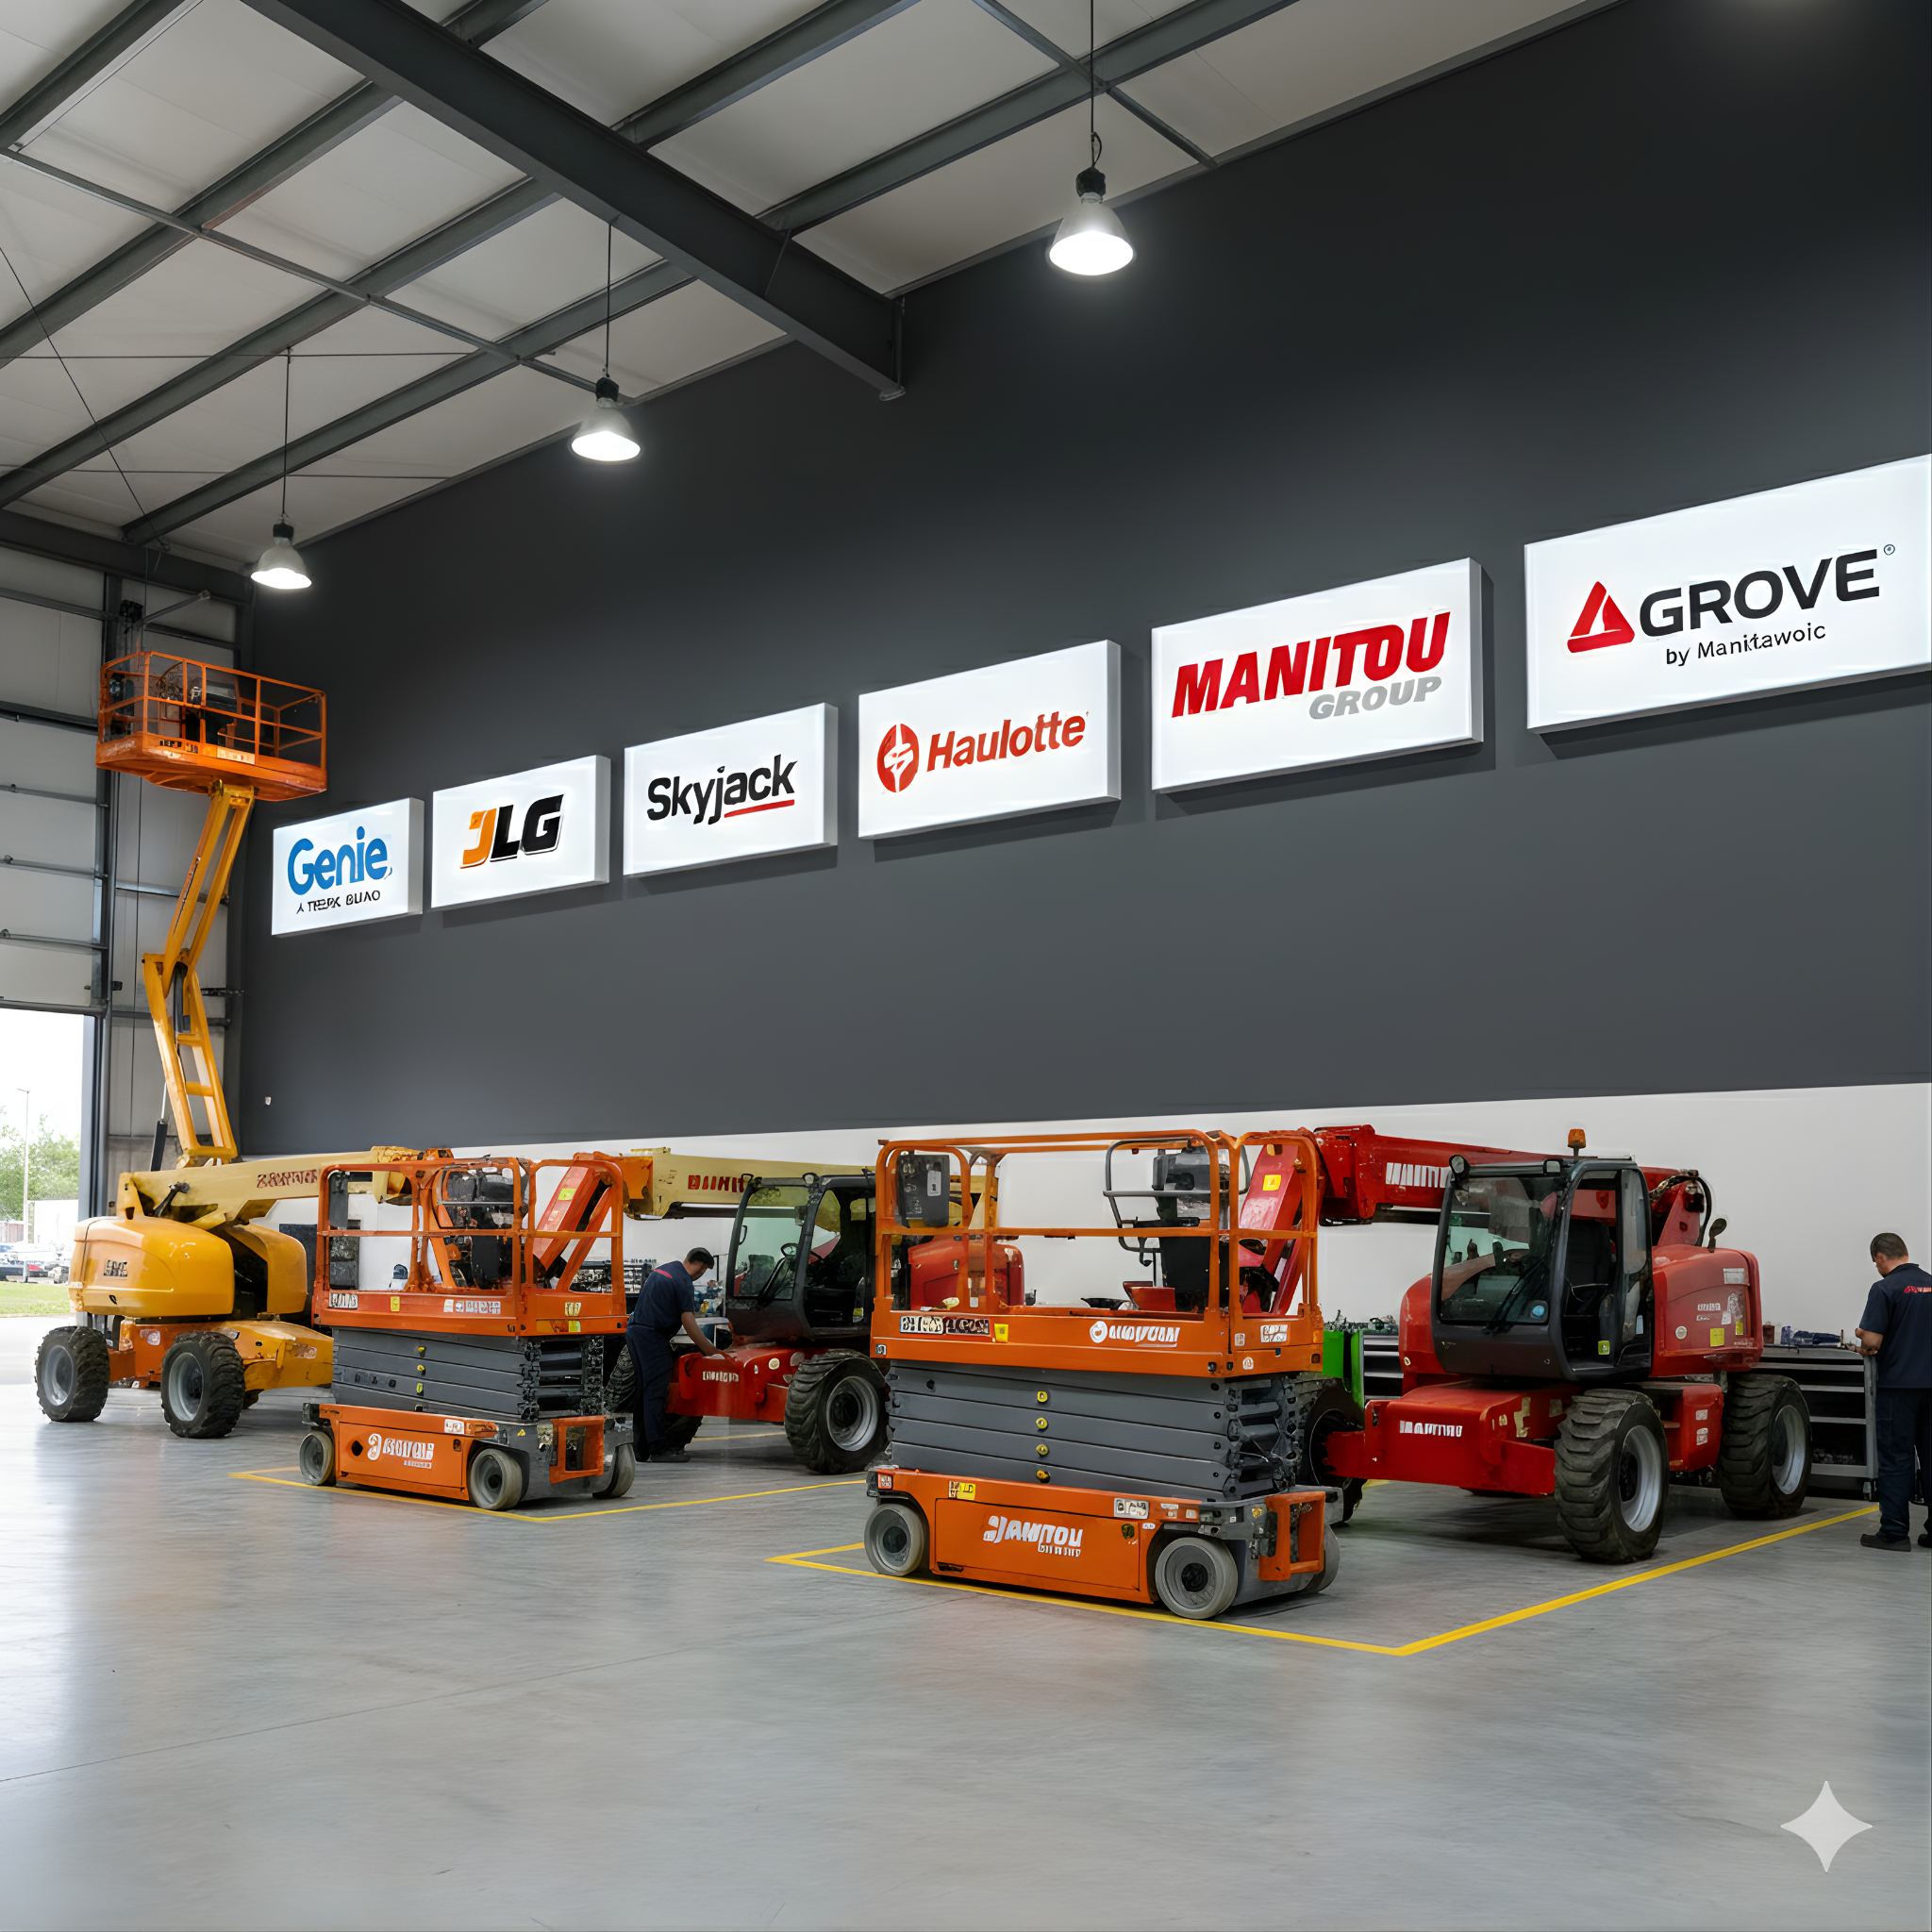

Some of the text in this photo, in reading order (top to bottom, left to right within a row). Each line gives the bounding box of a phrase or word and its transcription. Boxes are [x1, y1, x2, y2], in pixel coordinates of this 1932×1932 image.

[1640, 549, 1880, 638] GROVE
[1172, 612, 1450, 718] MANITOU
[1666, 648, 1691, 667] by
[1308, 675, 1442, 720] GROUP
[926, 711, 1087, 773] Haulotte
[646, 754, 798, 825] Skyjack
[287, 825, 389, 896] Genie
[459, 793, 564, 869] JLG
